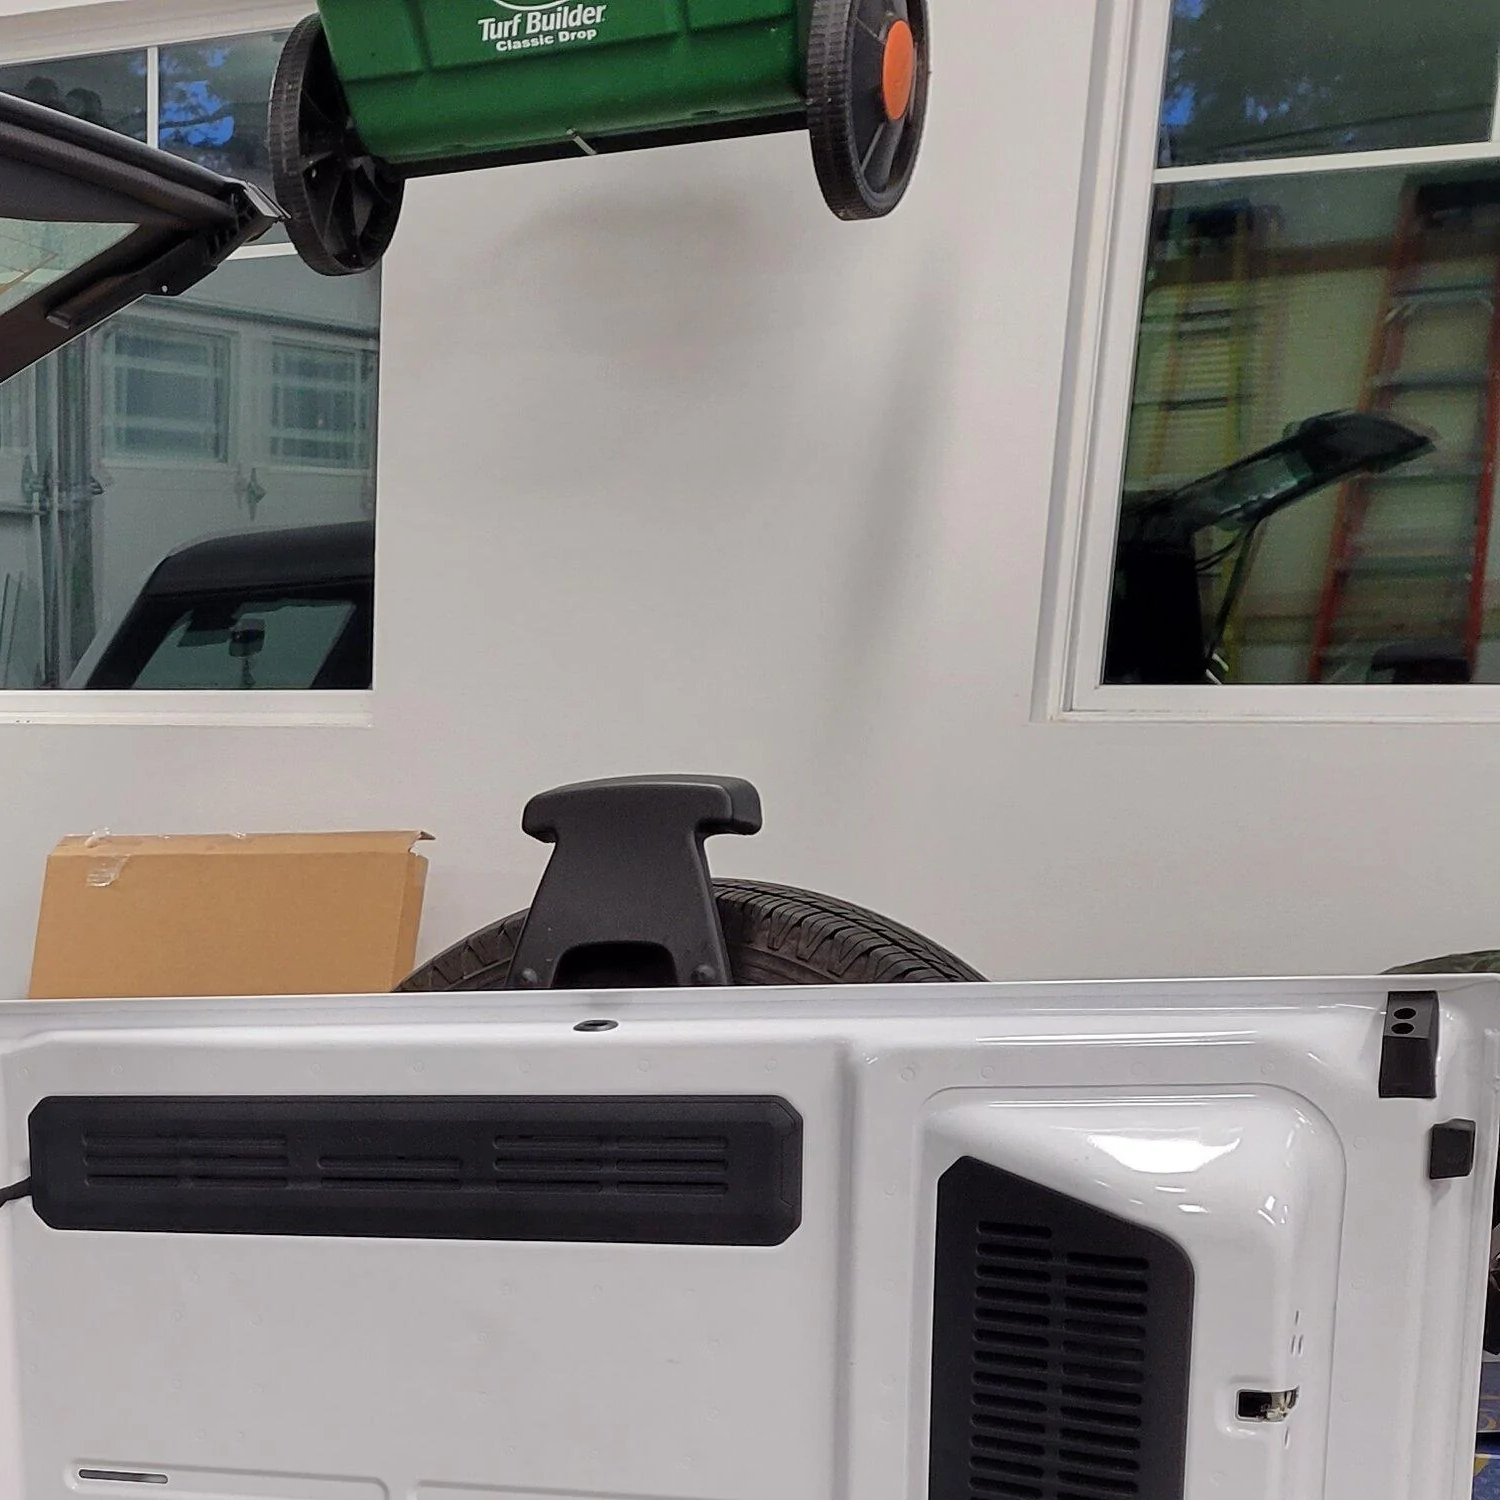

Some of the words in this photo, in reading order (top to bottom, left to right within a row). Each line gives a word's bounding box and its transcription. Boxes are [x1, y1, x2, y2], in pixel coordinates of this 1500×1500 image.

[477, 13, 522, 41] Turf
[526, 4, 606, 34] Builder
[496, 34, 554, 51] Classic
[558, 29, 597, 42] Drop
